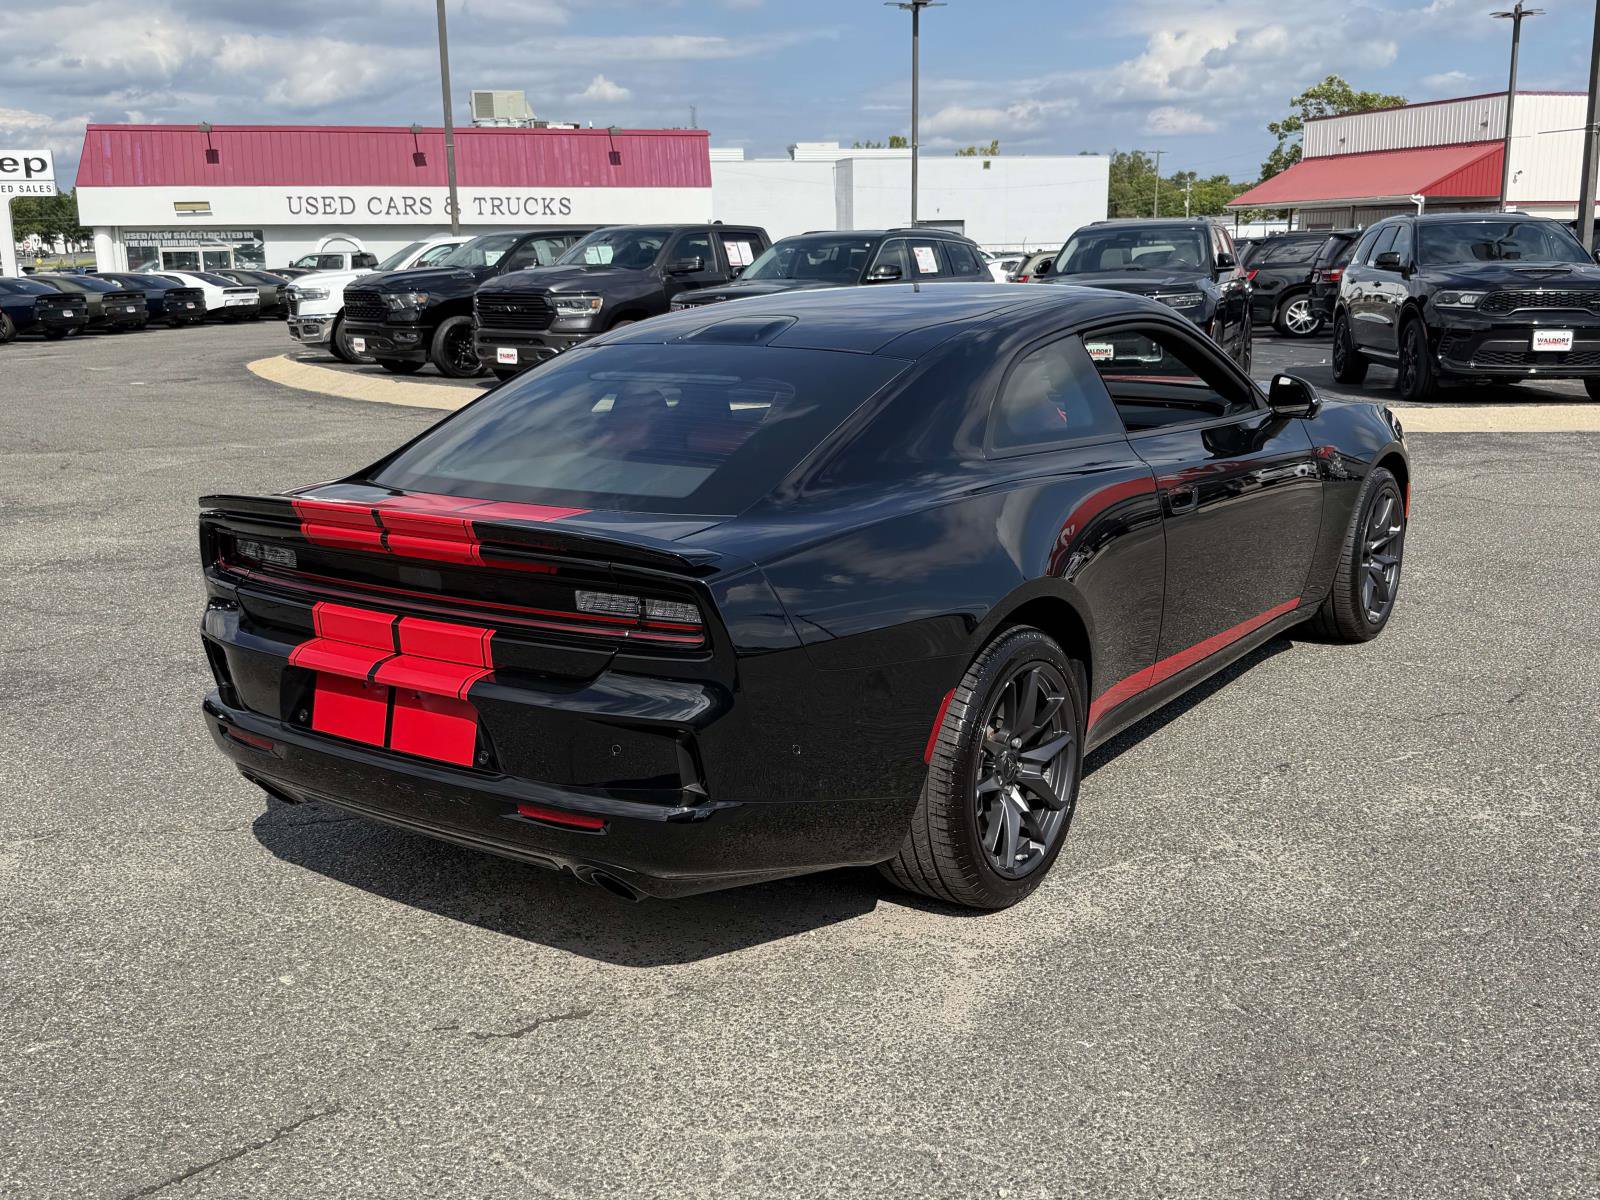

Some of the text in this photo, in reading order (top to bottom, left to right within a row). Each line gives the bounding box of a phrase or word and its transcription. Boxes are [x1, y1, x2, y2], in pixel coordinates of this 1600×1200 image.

[19, 185, 52, 193] SALES
[286, 196, 571, 215] USED CARS & TRUCKS
[124, 231, 254, 240] USED/NEW SALES LOCATED IN
